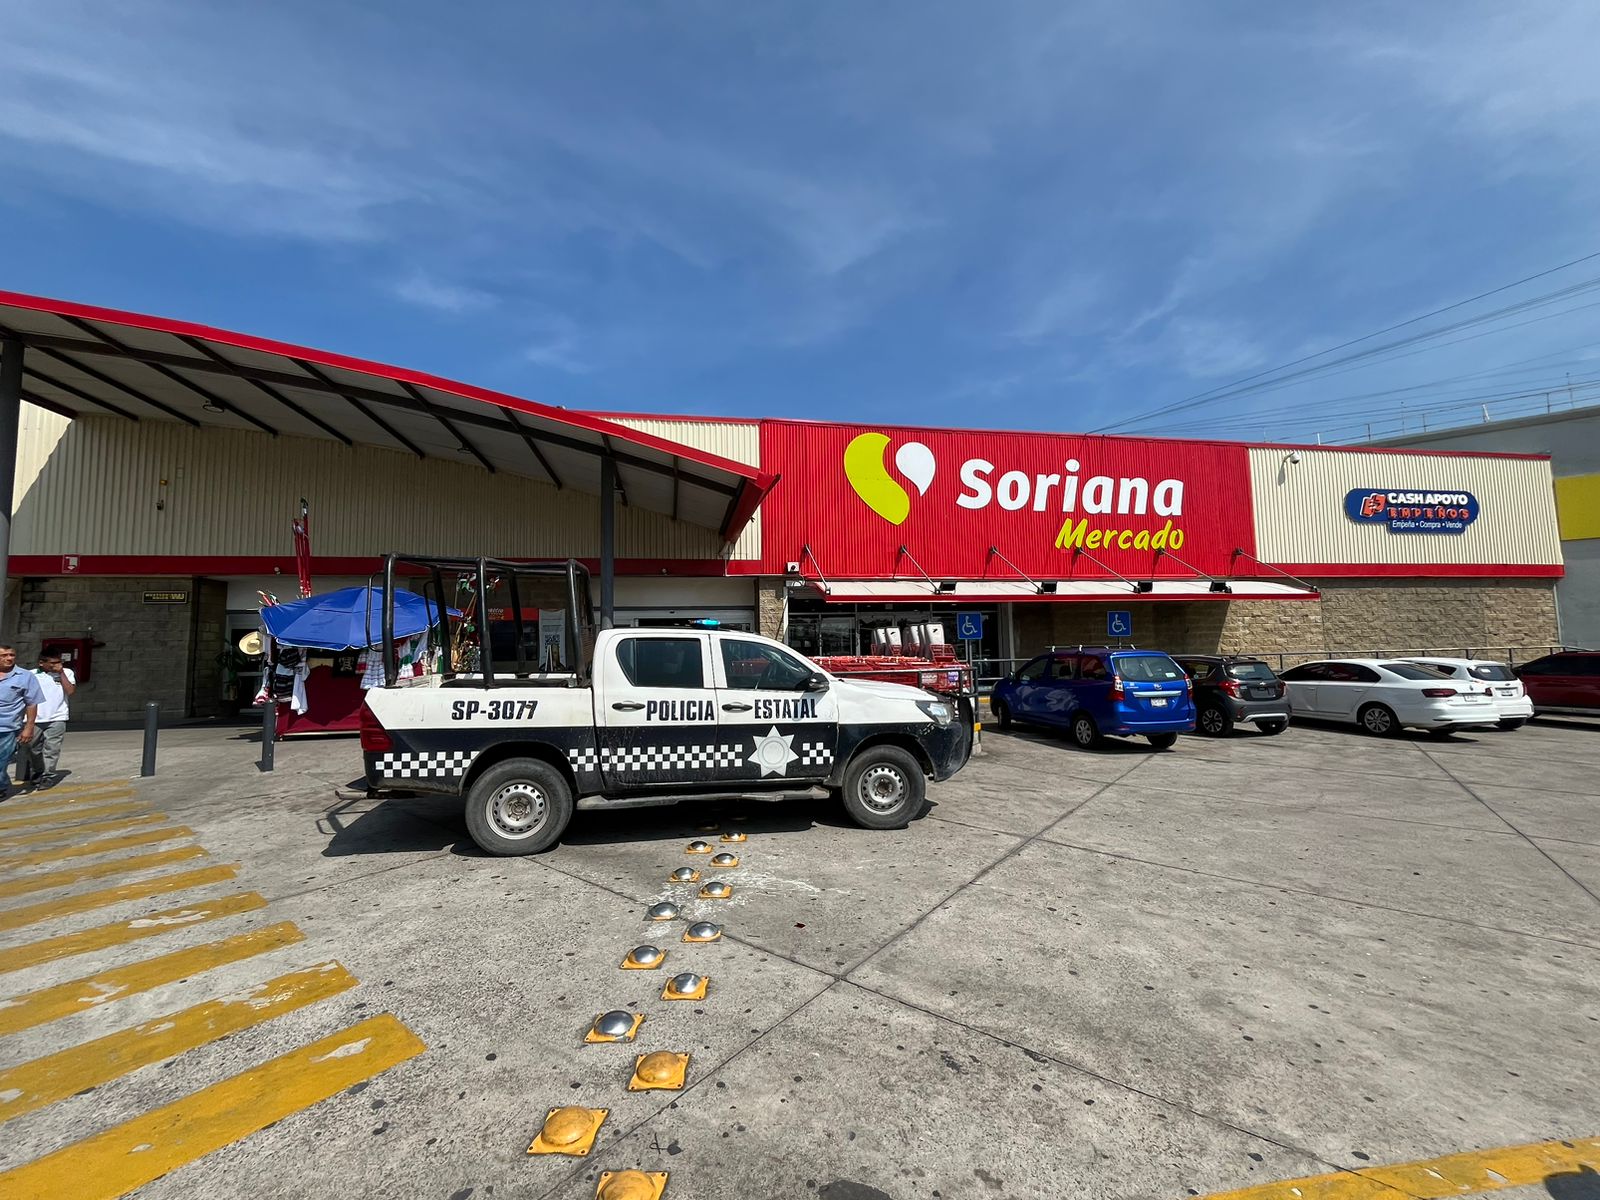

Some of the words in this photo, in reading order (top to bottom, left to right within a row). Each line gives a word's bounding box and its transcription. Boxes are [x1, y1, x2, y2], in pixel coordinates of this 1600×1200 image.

[956, 458, 1184, 517] Soriana
[1387, 492, 1424, 504] CASH
[1425, 493, 1469, 505] APOYO
[1387, 506, 1469, 519] EMPEÑOS
[1054, 517, 1185, 550] Mercado
[1392, 520, 1416, 530] Empeña
[1419, 521, 1441, 530] Compra
[1445, 521, 1463, 530] Vende
[451, 700, 538, 720] SP-3077
[646, 700, 715, 721] POLICIA
[754, 699, 818, 719] ESTATAL
